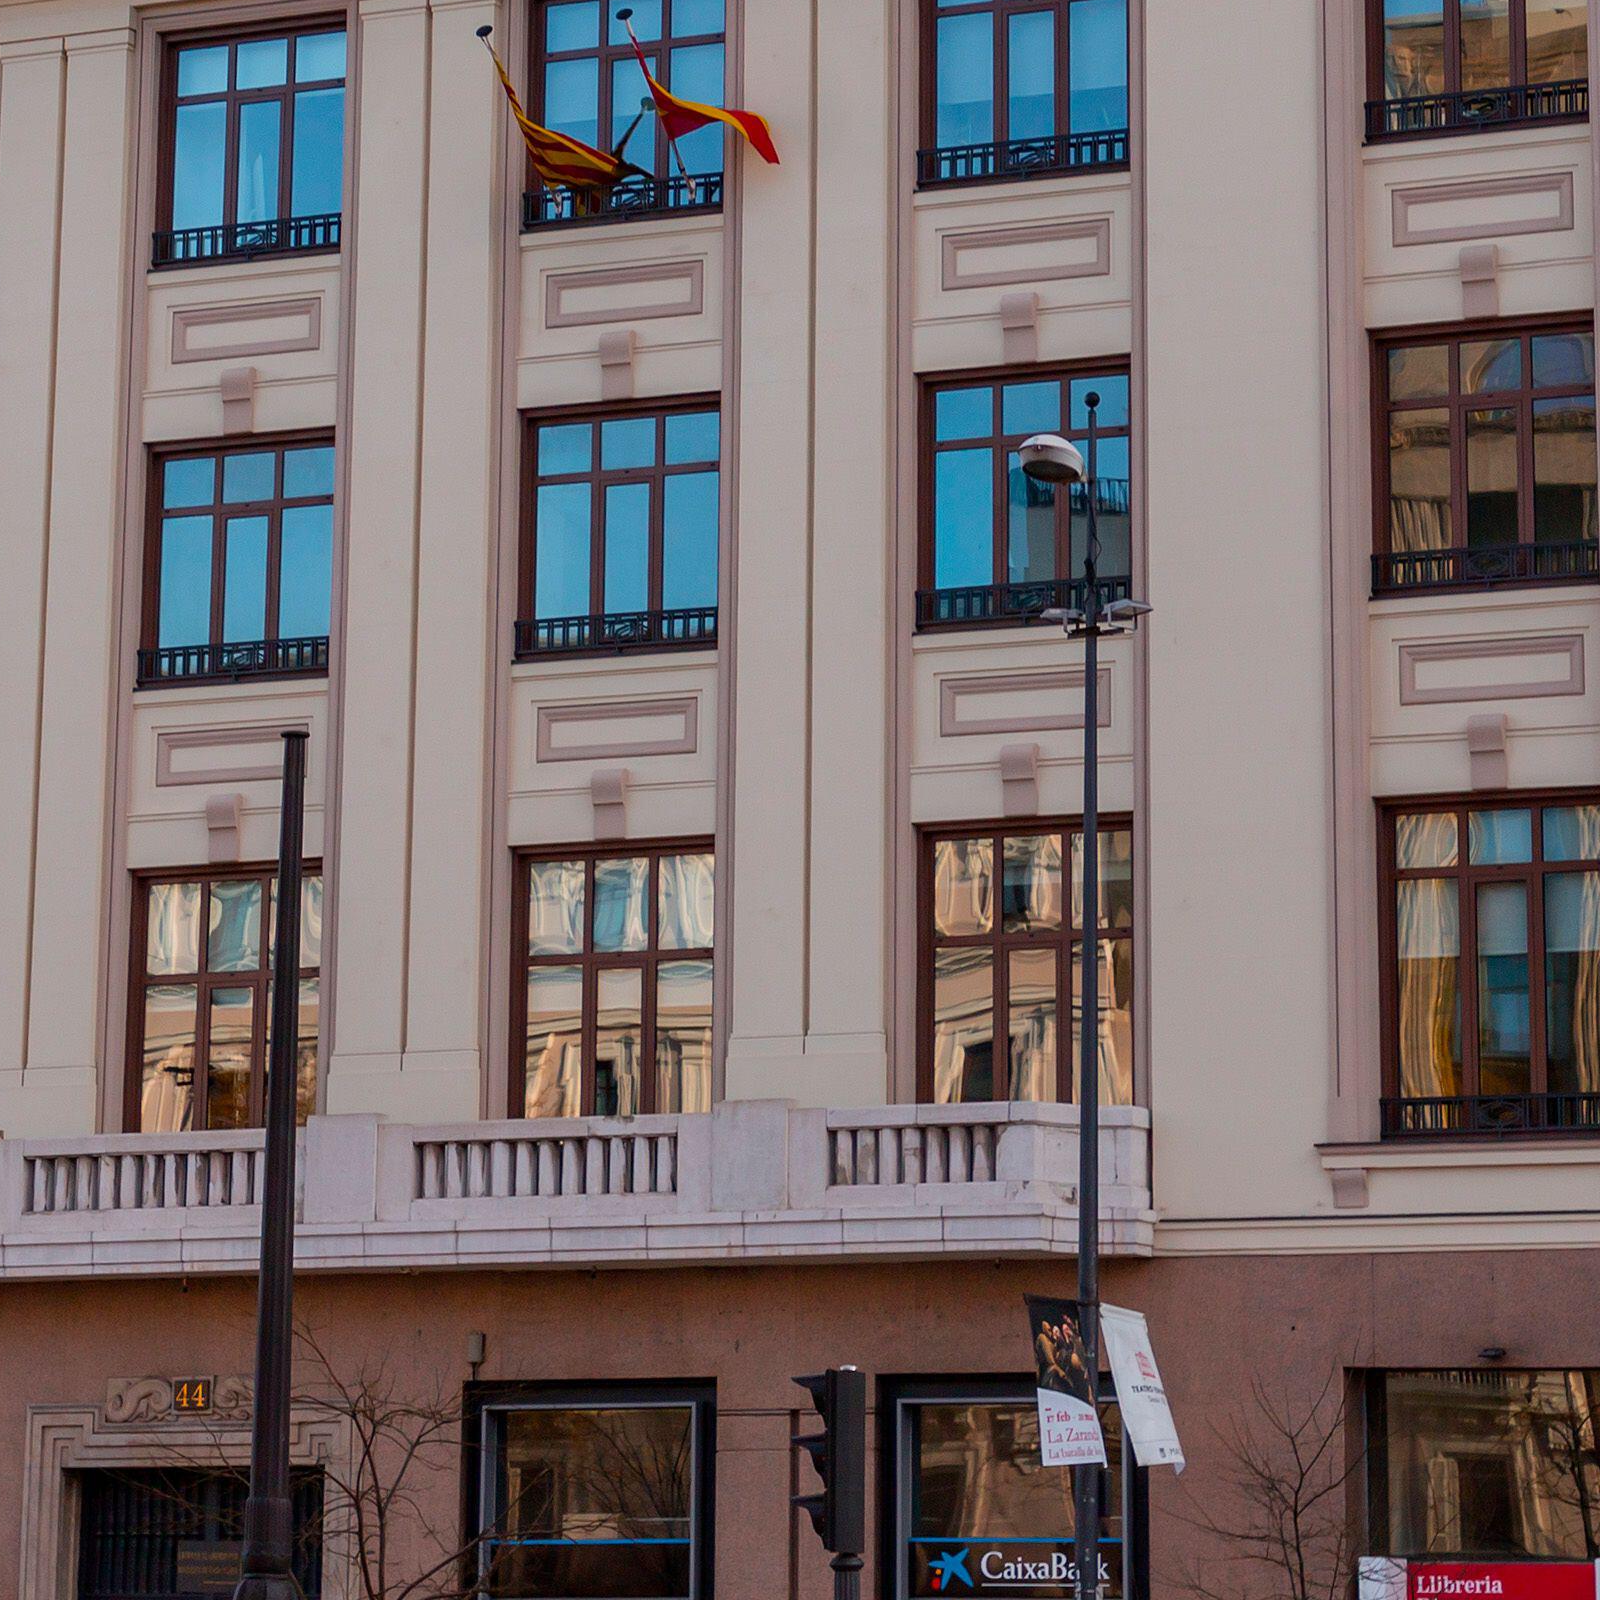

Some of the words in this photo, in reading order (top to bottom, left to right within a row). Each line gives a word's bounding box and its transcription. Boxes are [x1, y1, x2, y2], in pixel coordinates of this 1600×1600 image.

[175, 1382, 207, 1407] 44
[1047, 1429, 1063, 1443] La
[980, 1551, 1110, 1579] CaixaBak
[1416, 1575, 1503, 1594] Llibreria
